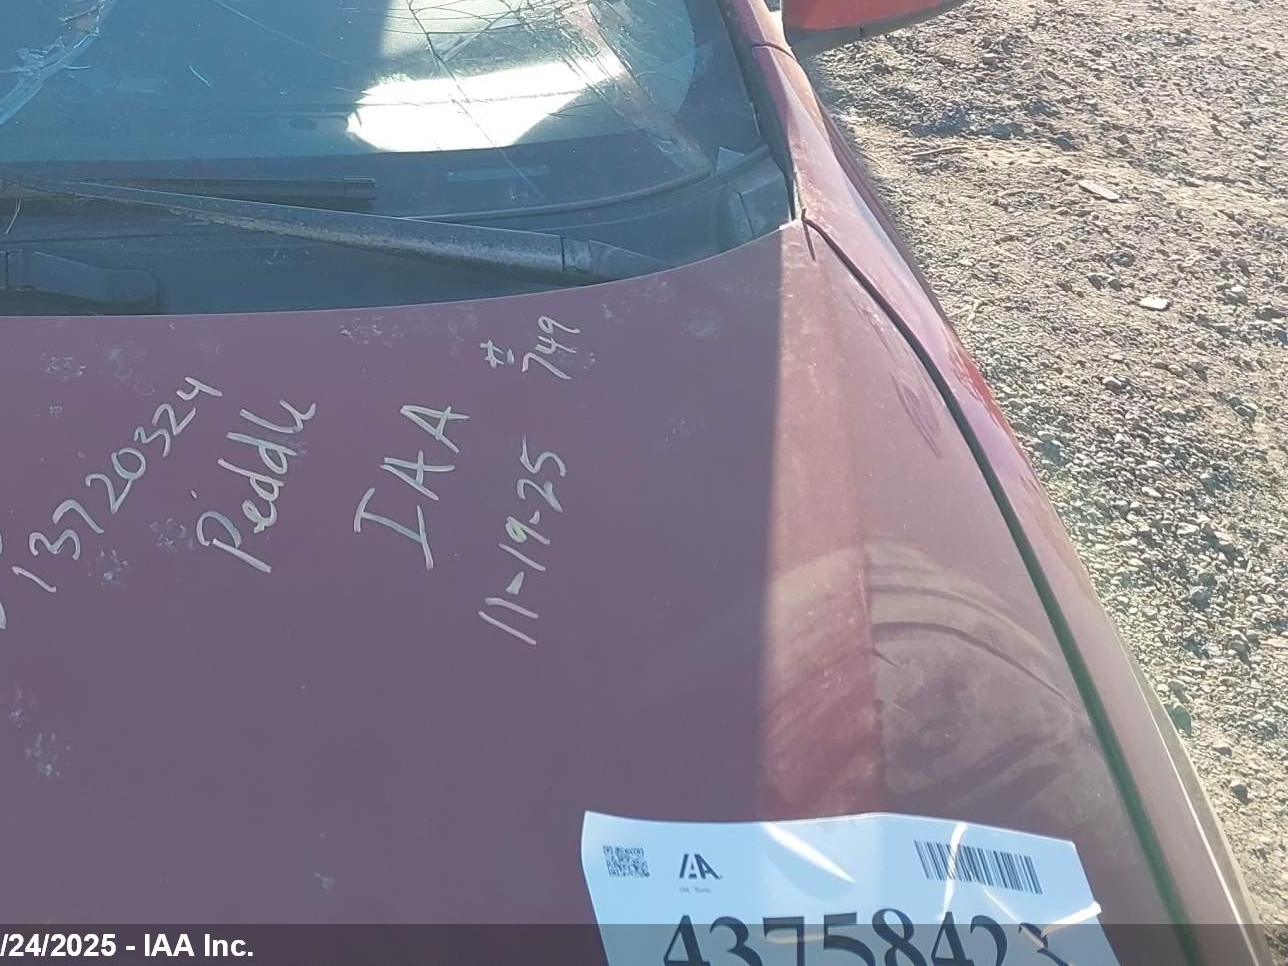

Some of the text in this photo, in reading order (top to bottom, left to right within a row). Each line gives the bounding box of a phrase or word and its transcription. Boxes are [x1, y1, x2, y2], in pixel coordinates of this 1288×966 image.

[521, 315, 580, 380] 749
[12, 376, 223, 592] 13720324
[353, 404, 470, 570] IAA
[478, 434, 566, 646] 11-19-25
